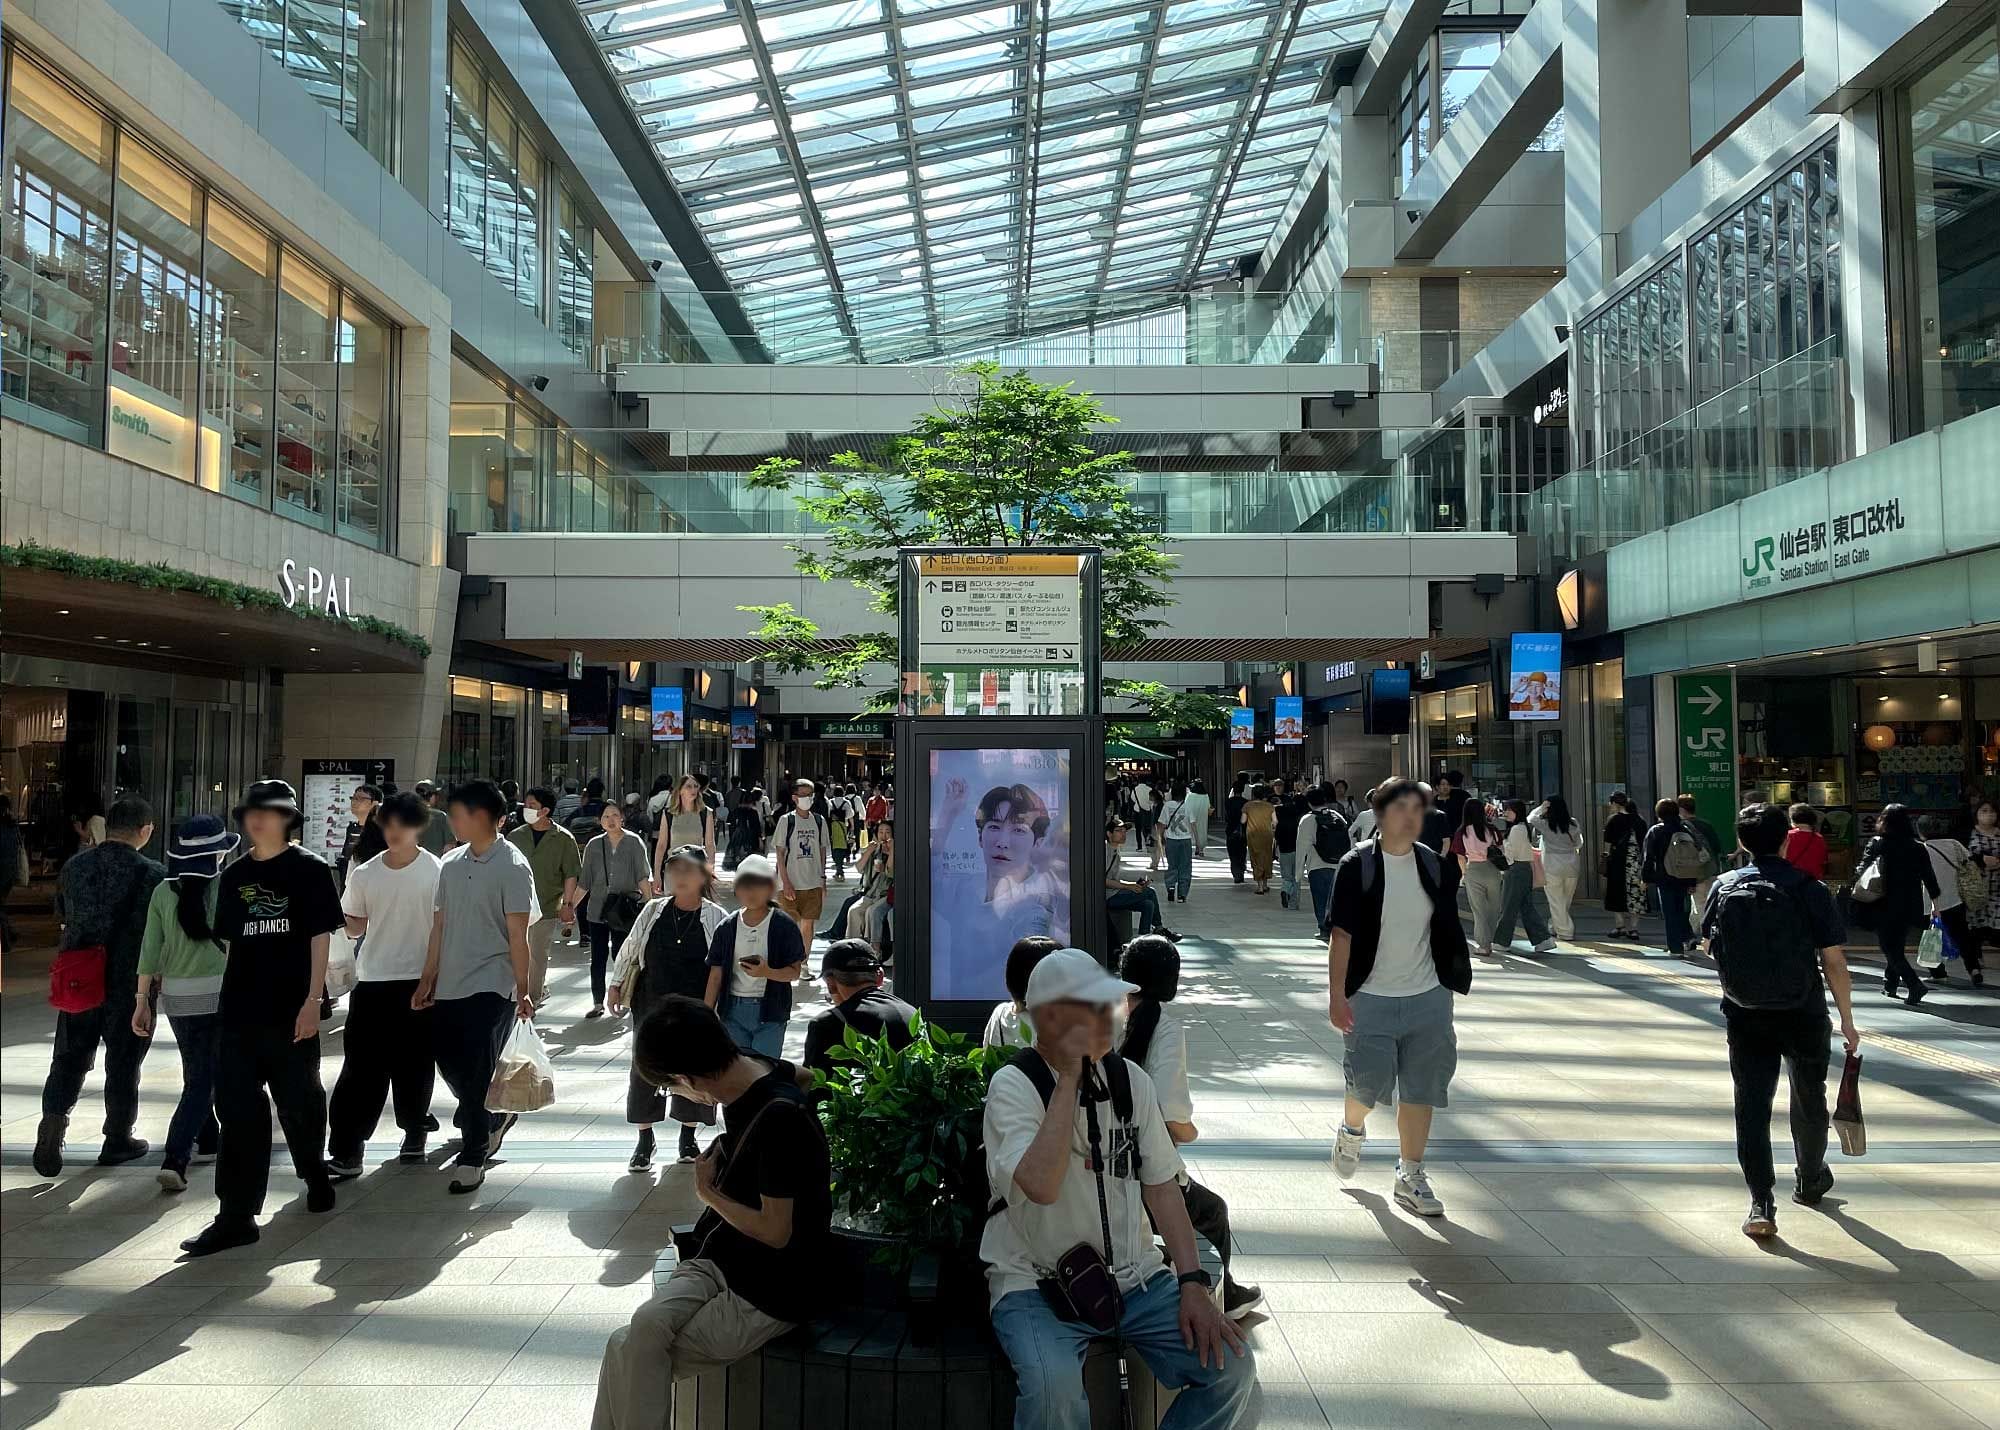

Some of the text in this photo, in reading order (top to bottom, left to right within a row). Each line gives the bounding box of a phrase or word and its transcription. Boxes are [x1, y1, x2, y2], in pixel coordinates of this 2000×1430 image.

[112, 404, 150, 436] Smith
[1780, 497, 1905, 561] 仙台駅 東口改札
[1742, 536, 1776, 577] JR
[1780, 546, 1870, 582] Sendai Station East Gate
[839, 724, 879, 732] HANDS
[1686, 727, 1727, 750] JR
